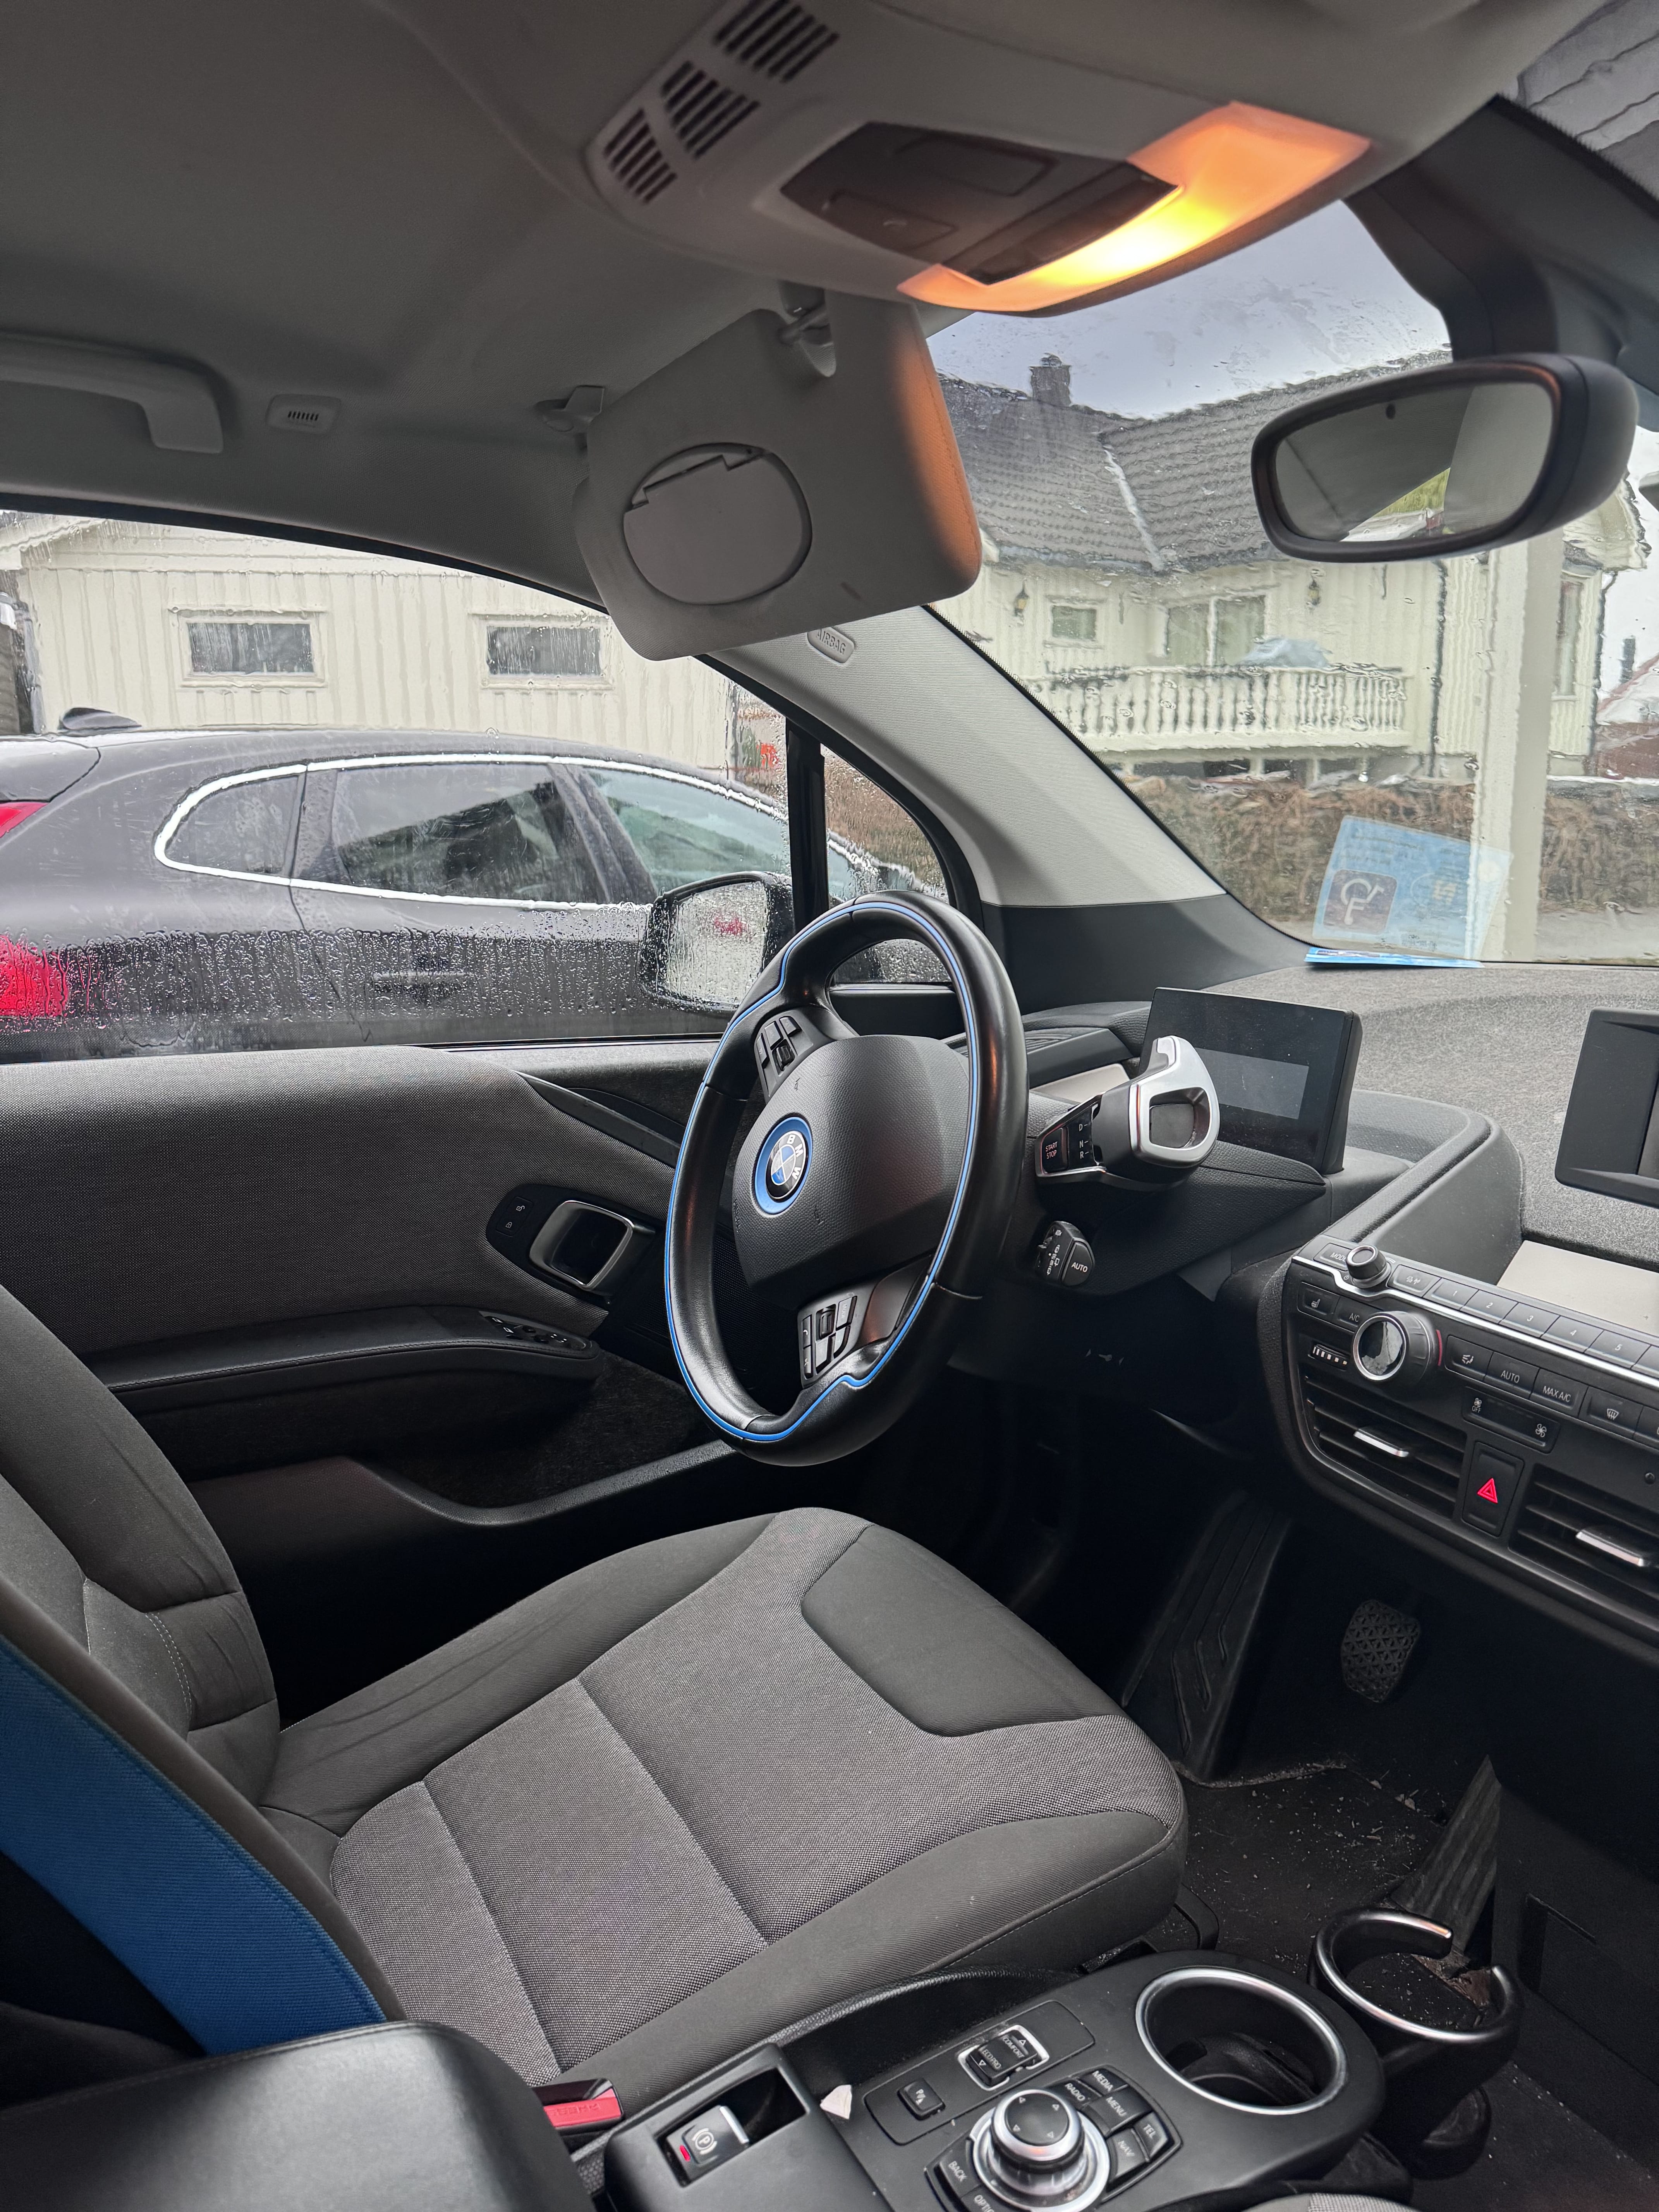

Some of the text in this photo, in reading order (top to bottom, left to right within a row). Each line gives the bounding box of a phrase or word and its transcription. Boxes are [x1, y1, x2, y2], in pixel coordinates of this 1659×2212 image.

[816, 629, 846, 654] AIRBAG
[1046, 1141, 1058, 1152] START
[1079, 1140, 1084, 1148] N
[787, 1134, 804, 1180] BMW
[1046, 1150, 1057, 1159] STOP
[1080, 1151, 1084, 1159] R
[1071, 1262, 1088, 1273] AUTO
[1349, 1313, 1360, 1322] A/C
[1500, 1370, 1520, 1384] AUTO
[1542, 1385, 1571, 1403] MAX A/C
[1003, 2037, 1025, 2058] COMFORT
[982, 2049, 1002, 2069] ECO PRO
[1092, 2070, 1113, 2092] MEDIA
[1065, 2083, 1085, 2101] RADIO
[1106, 2096, 1127, 2117] MENU
[1143, 2124, 1156, 2138] TEL
[1118, 2140, 1135, 2157] NAV
[948, 2160, 967, 2182] BACK
